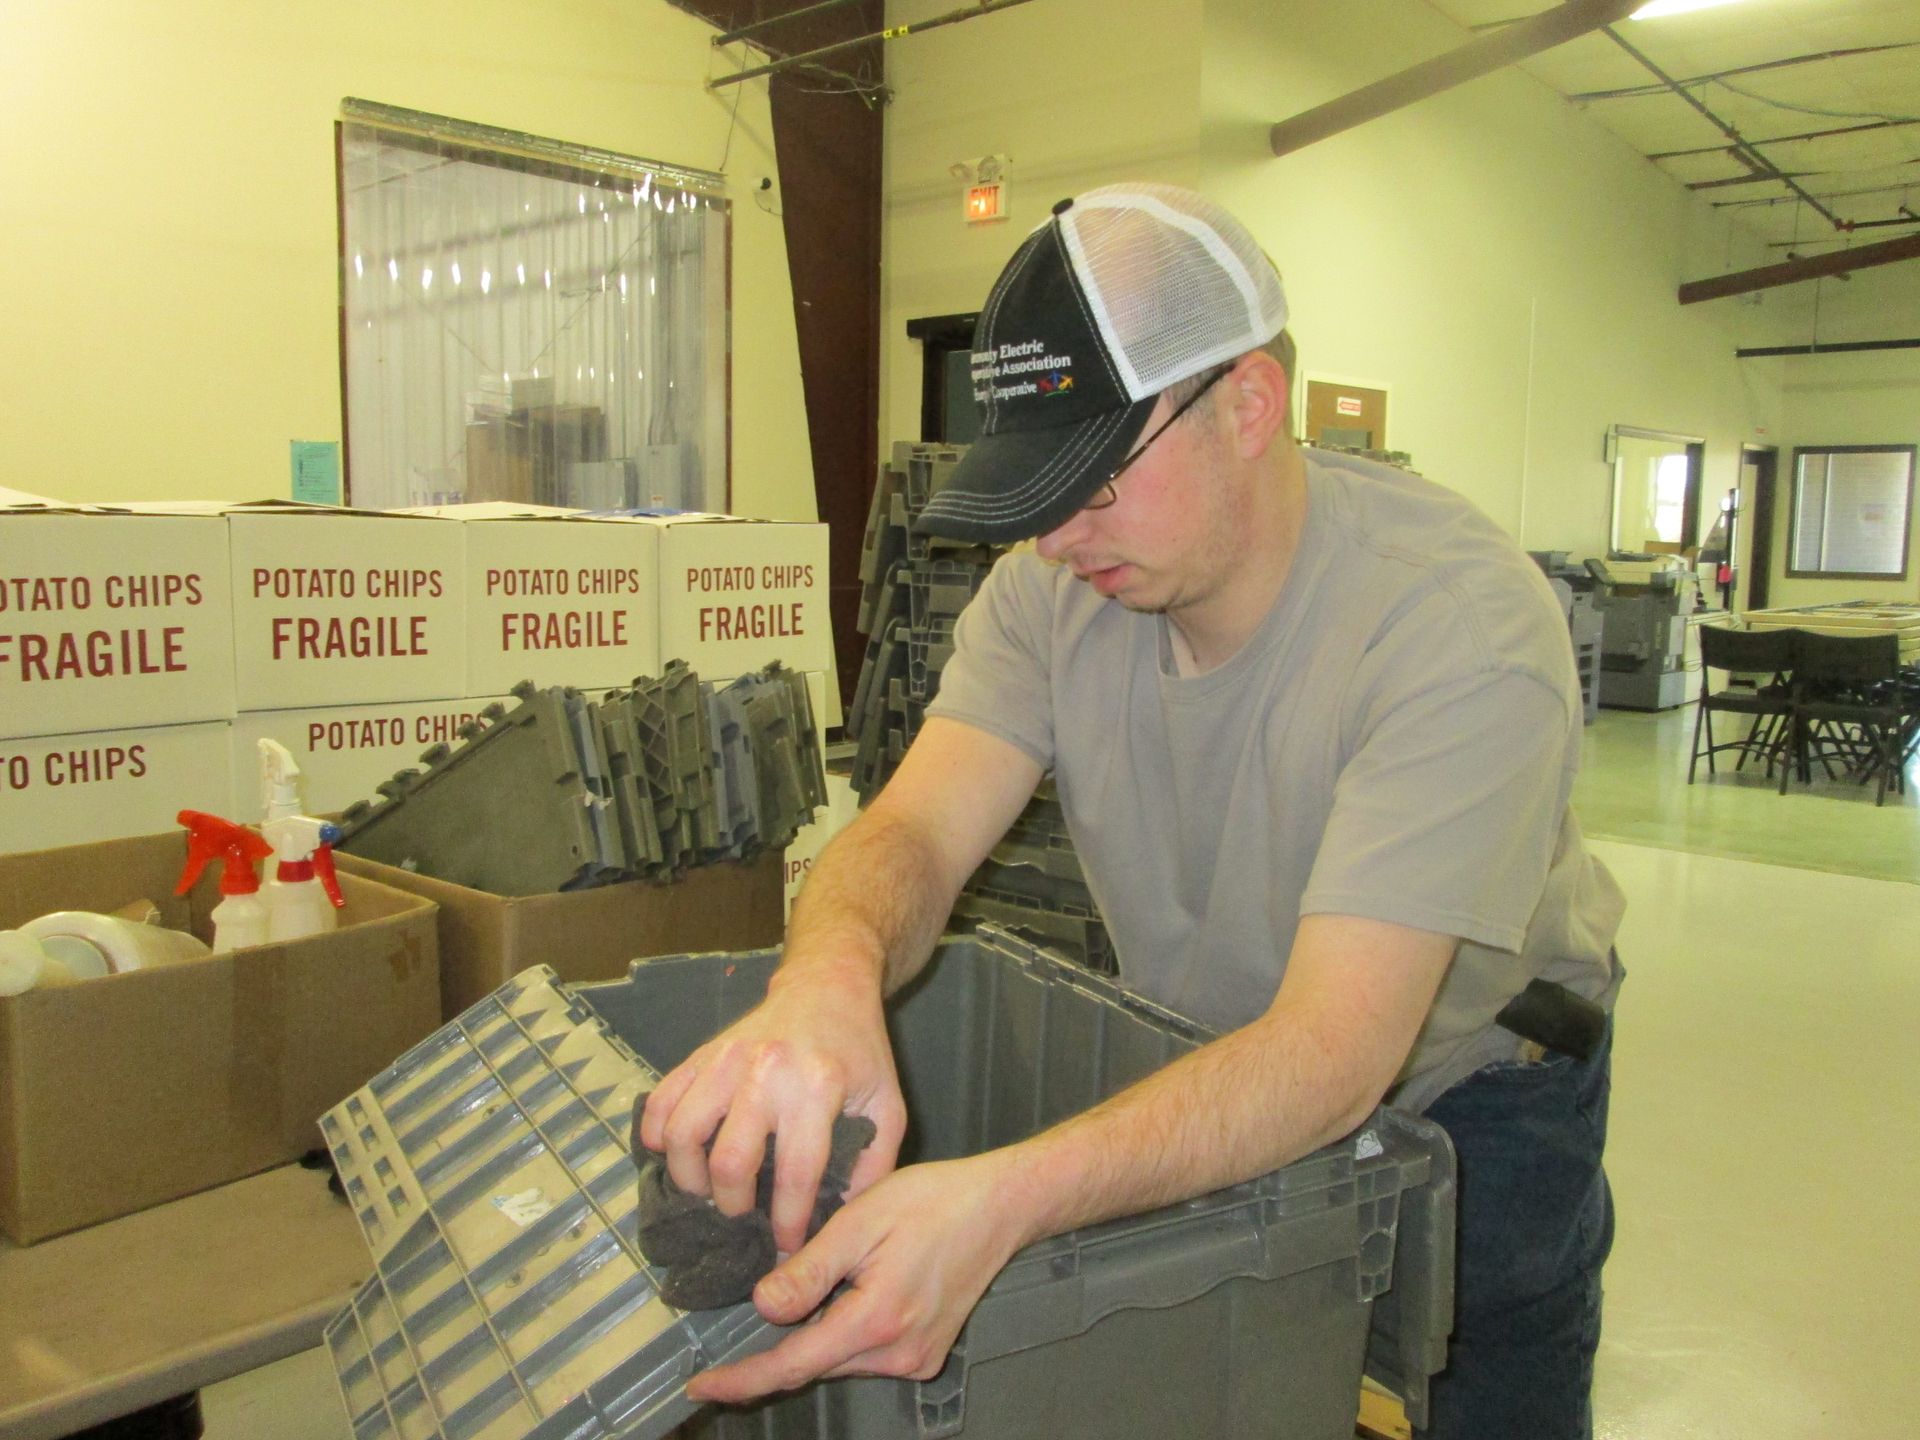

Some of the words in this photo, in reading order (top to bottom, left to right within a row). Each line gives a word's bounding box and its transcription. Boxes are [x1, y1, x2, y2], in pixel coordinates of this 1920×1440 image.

[1000, 340, 1044, 359] Electric
[1003, 355, 1072, 375] Association
[105, 574, 203, 609] CHIPS
[253, 569, 355, 599] POTATO
[367, 570, 443, 598] CHIPS
[487, 569, 569, 596] POTATO
[578, 568, 640, 595] CHIPS
[687, 567, 755, 592] POTATO
[762, 565, 814, 590] CHIPS
[272, 616, 428, 660] FRAGILE
[502, 611, 628, 651] FRAGILE
[700, 603, 805, 642] FRAGILE
[308, 718, 405, 752] POTATO
[45, 745, 147, 787] CHIPS
